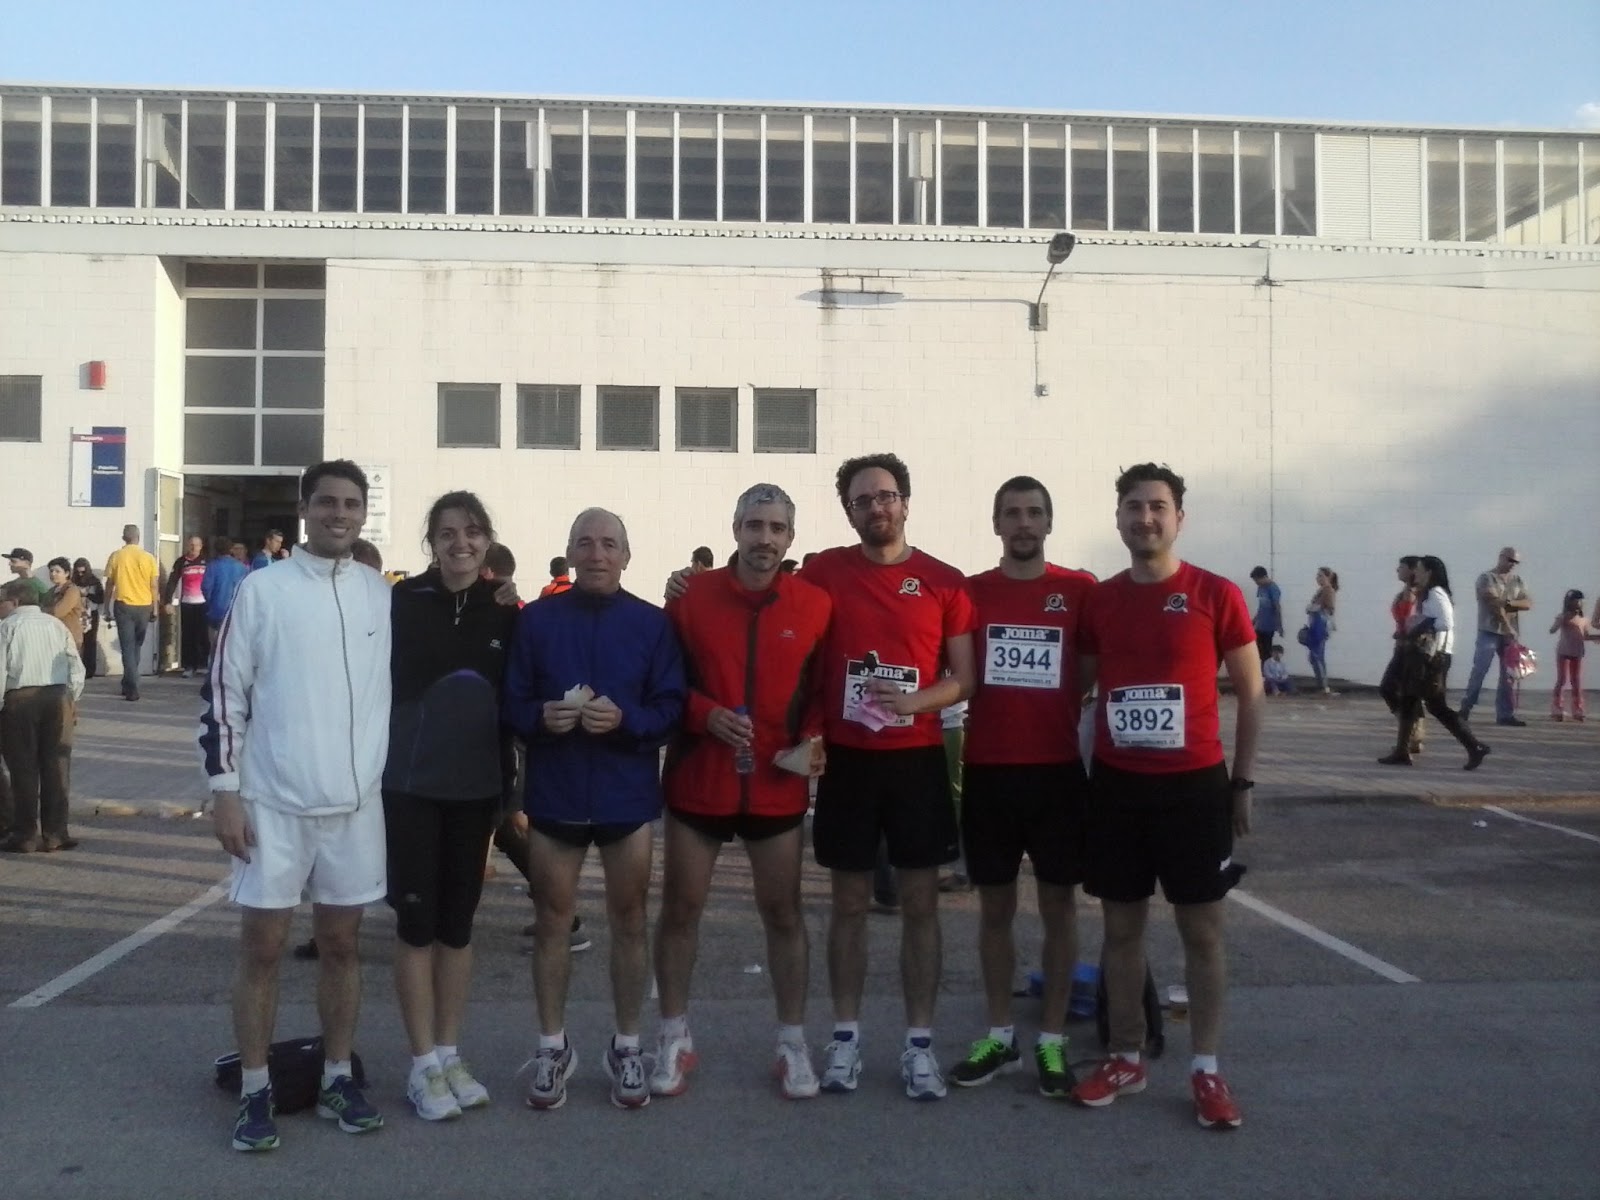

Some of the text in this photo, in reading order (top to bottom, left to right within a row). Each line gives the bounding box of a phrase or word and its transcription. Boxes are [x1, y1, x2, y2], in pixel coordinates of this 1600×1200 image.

[1001, 627, 1047, 640] Joma
[993, 645, 1052, 671] 3944
[1121, 687, 1168, 703] Joma
[1114, 707, 1175, 732] 3892
